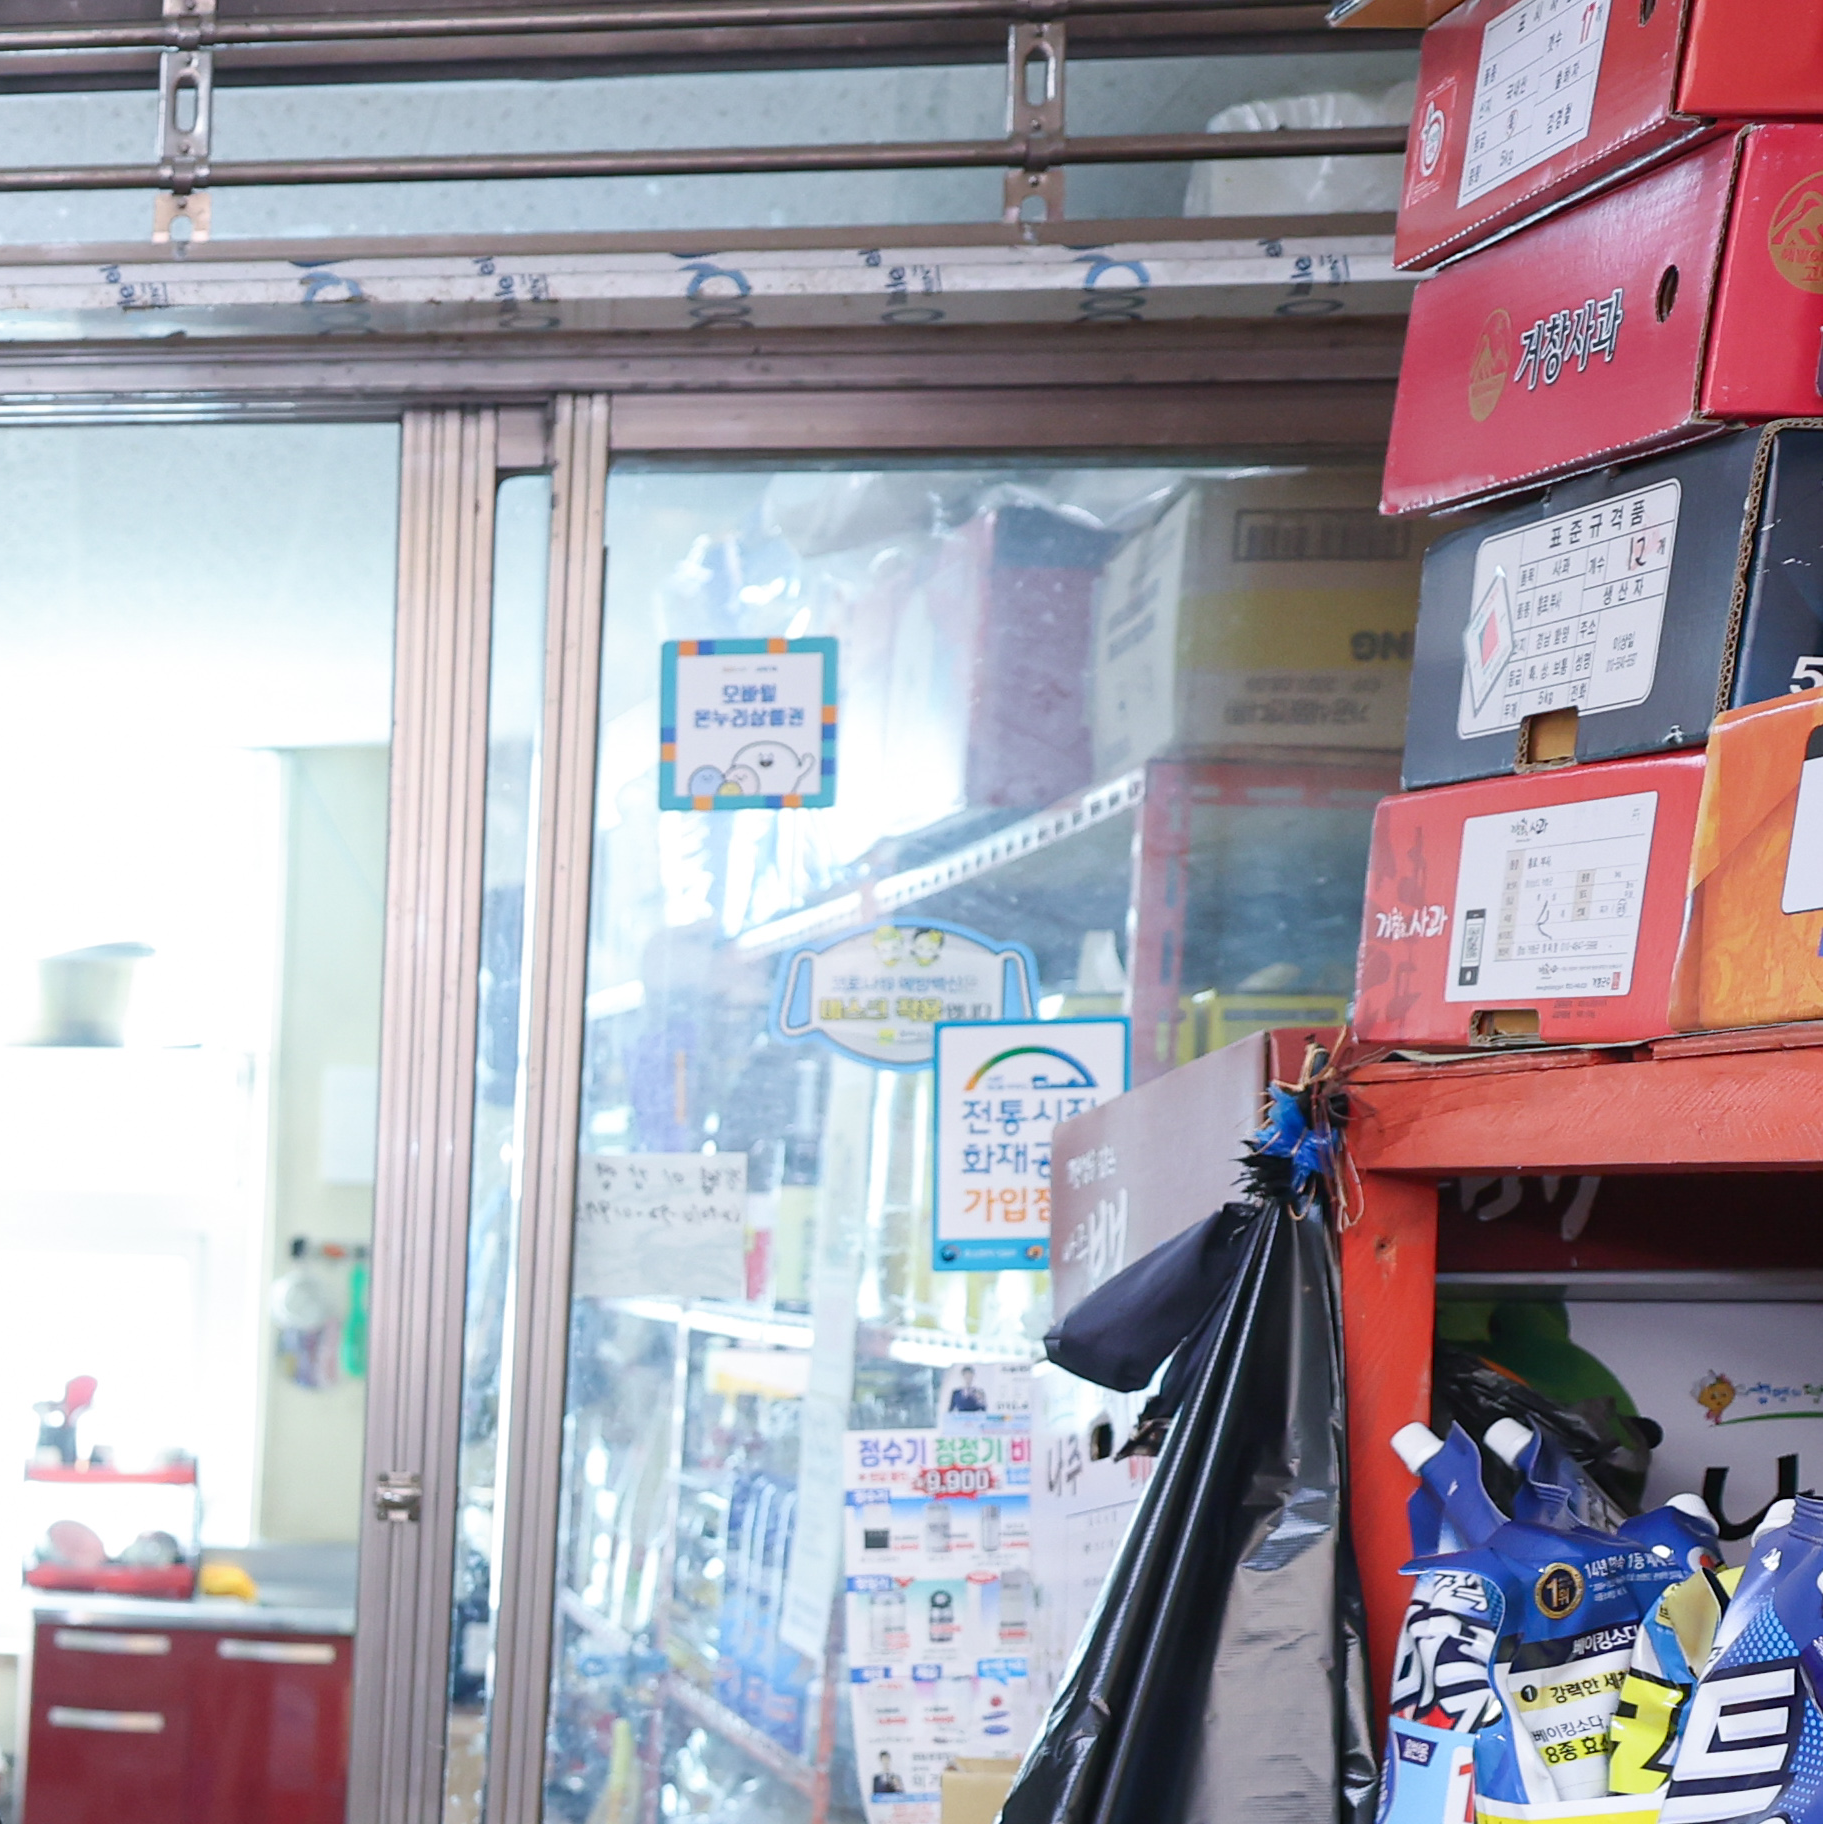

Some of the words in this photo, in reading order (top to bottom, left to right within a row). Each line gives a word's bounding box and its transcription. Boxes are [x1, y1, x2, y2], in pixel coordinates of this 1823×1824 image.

[1514, 287, 1623, 390] 거창사과
[1549, 499, 1645, 549] 표준규격품
[1603, 576, 1644, 606] 생산자
[961, 1141, 1052, 1179] 화재공
[860, 1437, 928, 1468] 정수기
[1573, 1624, 1637, 1656] 베이킹소다
[1550, 1678, 1601, 1704] 강력한
[1545, 1741, 1577, 1764] 8종
